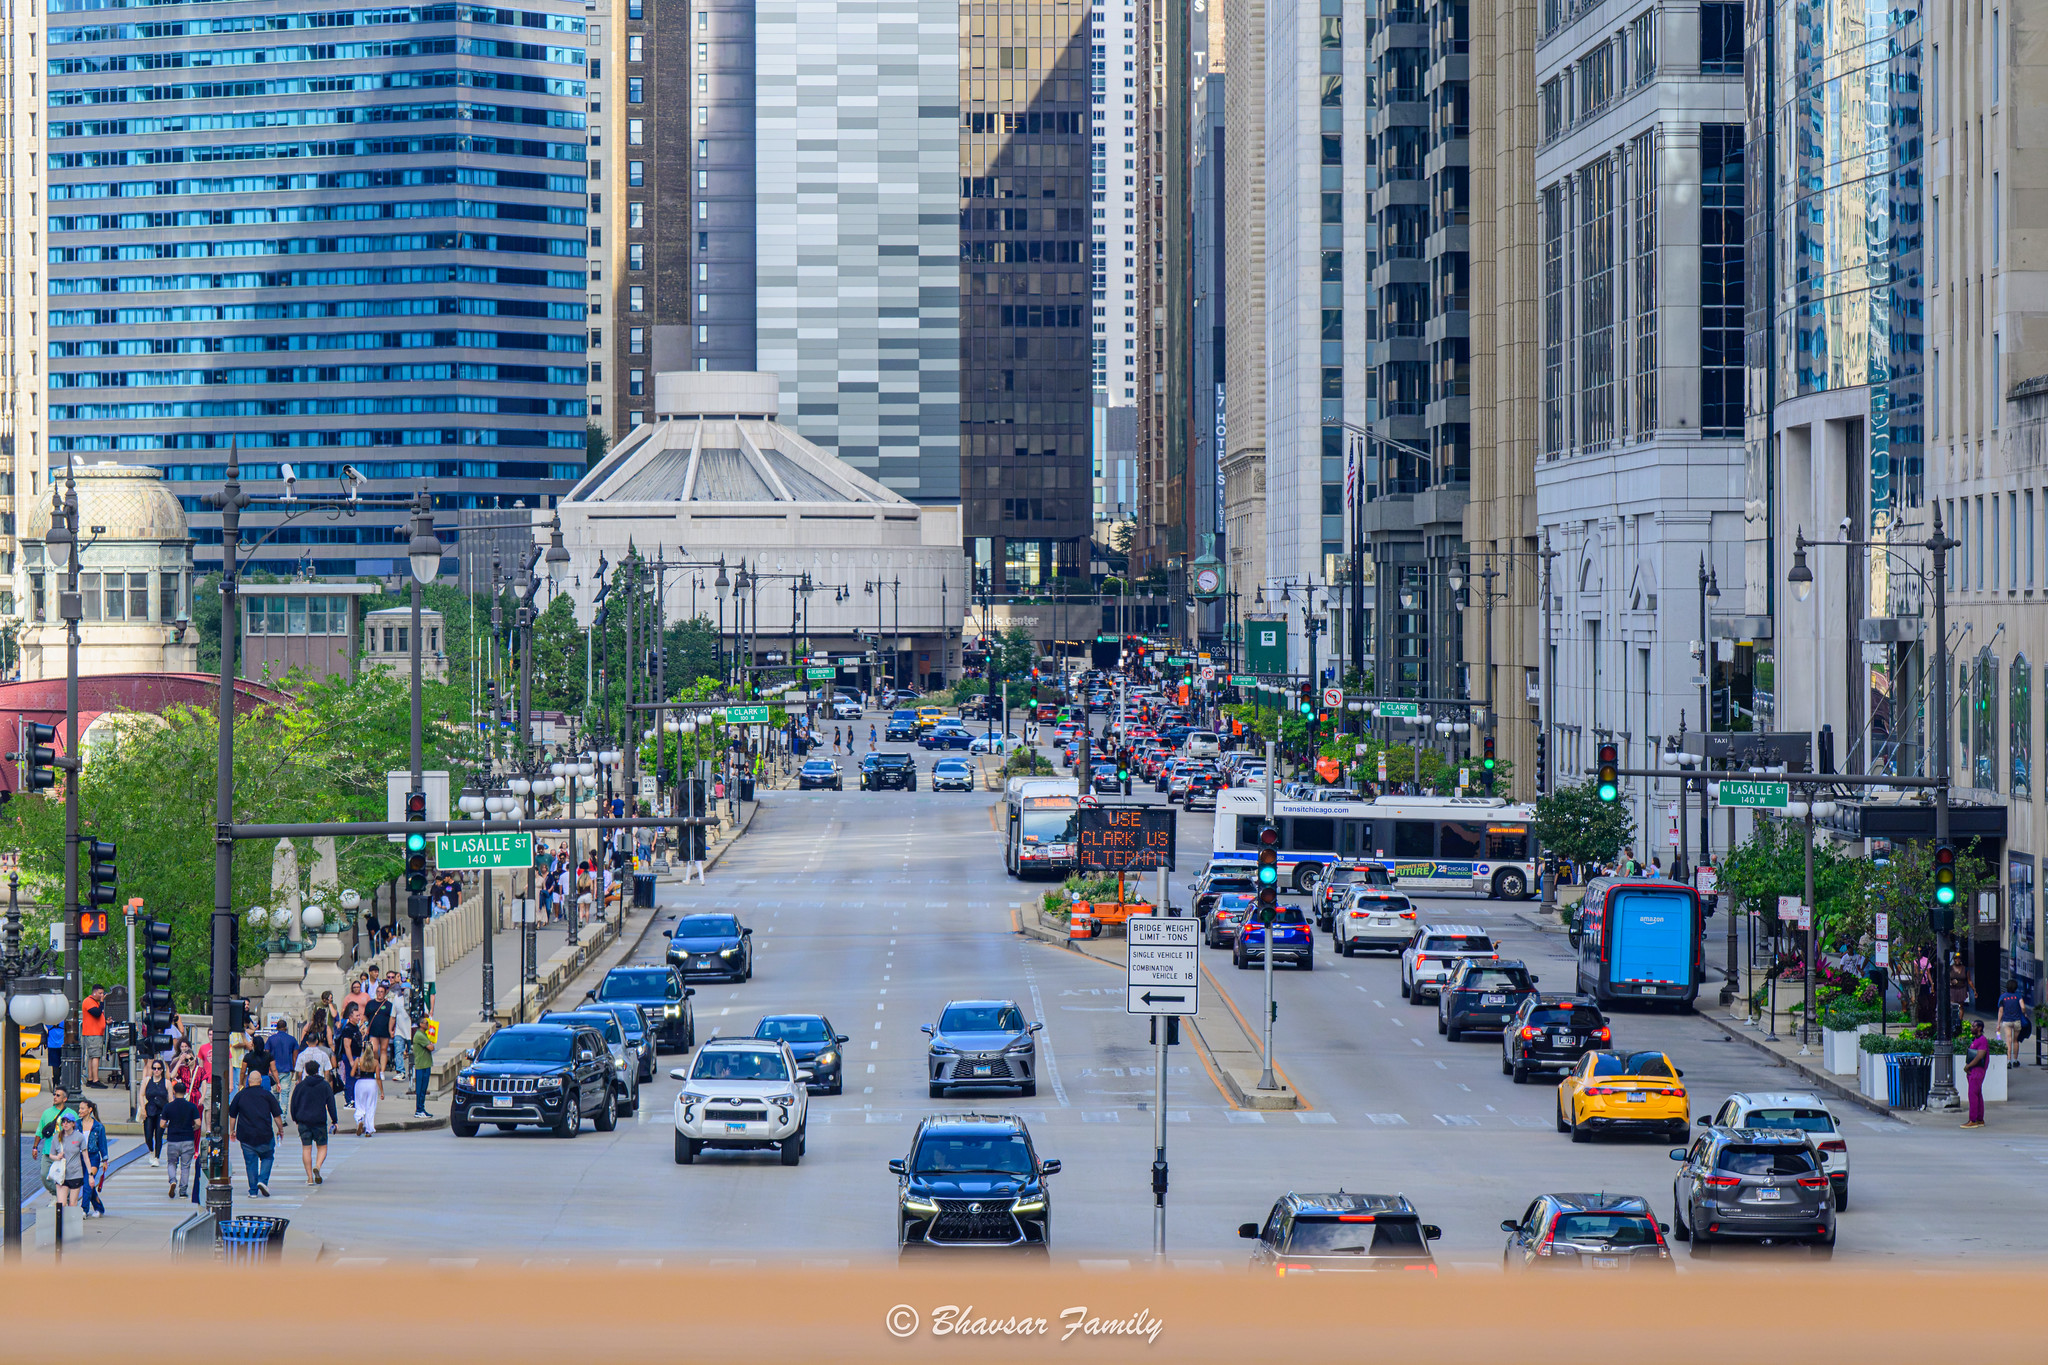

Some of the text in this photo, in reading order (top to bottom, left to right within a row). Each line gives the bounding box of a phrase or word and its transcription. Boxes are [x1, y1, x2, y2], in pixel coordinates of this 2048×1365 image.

[758, 552, 856, 565] CHURCH
[1005, 615, 1039, 626] center
[734, 708, 758, 716] CLARK
[1722, 785, 1728, 793] N
[1775, 786, 1785, 795] ST
[1741, 796, 1755, 804] 140
[1283, 805, 1349, 815] transitchicago.com
[1109, 811, 1142, 827] USE
[1081, 831, 1169, 846] CLARK US
[441, 841, 448, 851] N
[515, 838, 527, 849] ST
[468, 854, 502, 864] 140 W
[1080, 850, 1168, 866] ALTERNAT
[1395, 867, 1430, 876] FUTURE
[98, 913, 107, 931] 8
[1133, 924, 1194, 932] BRIDGE WEIGHT
[1186, 951, 1193, 959] 11
[1184, 972, 1194, 980] 18
